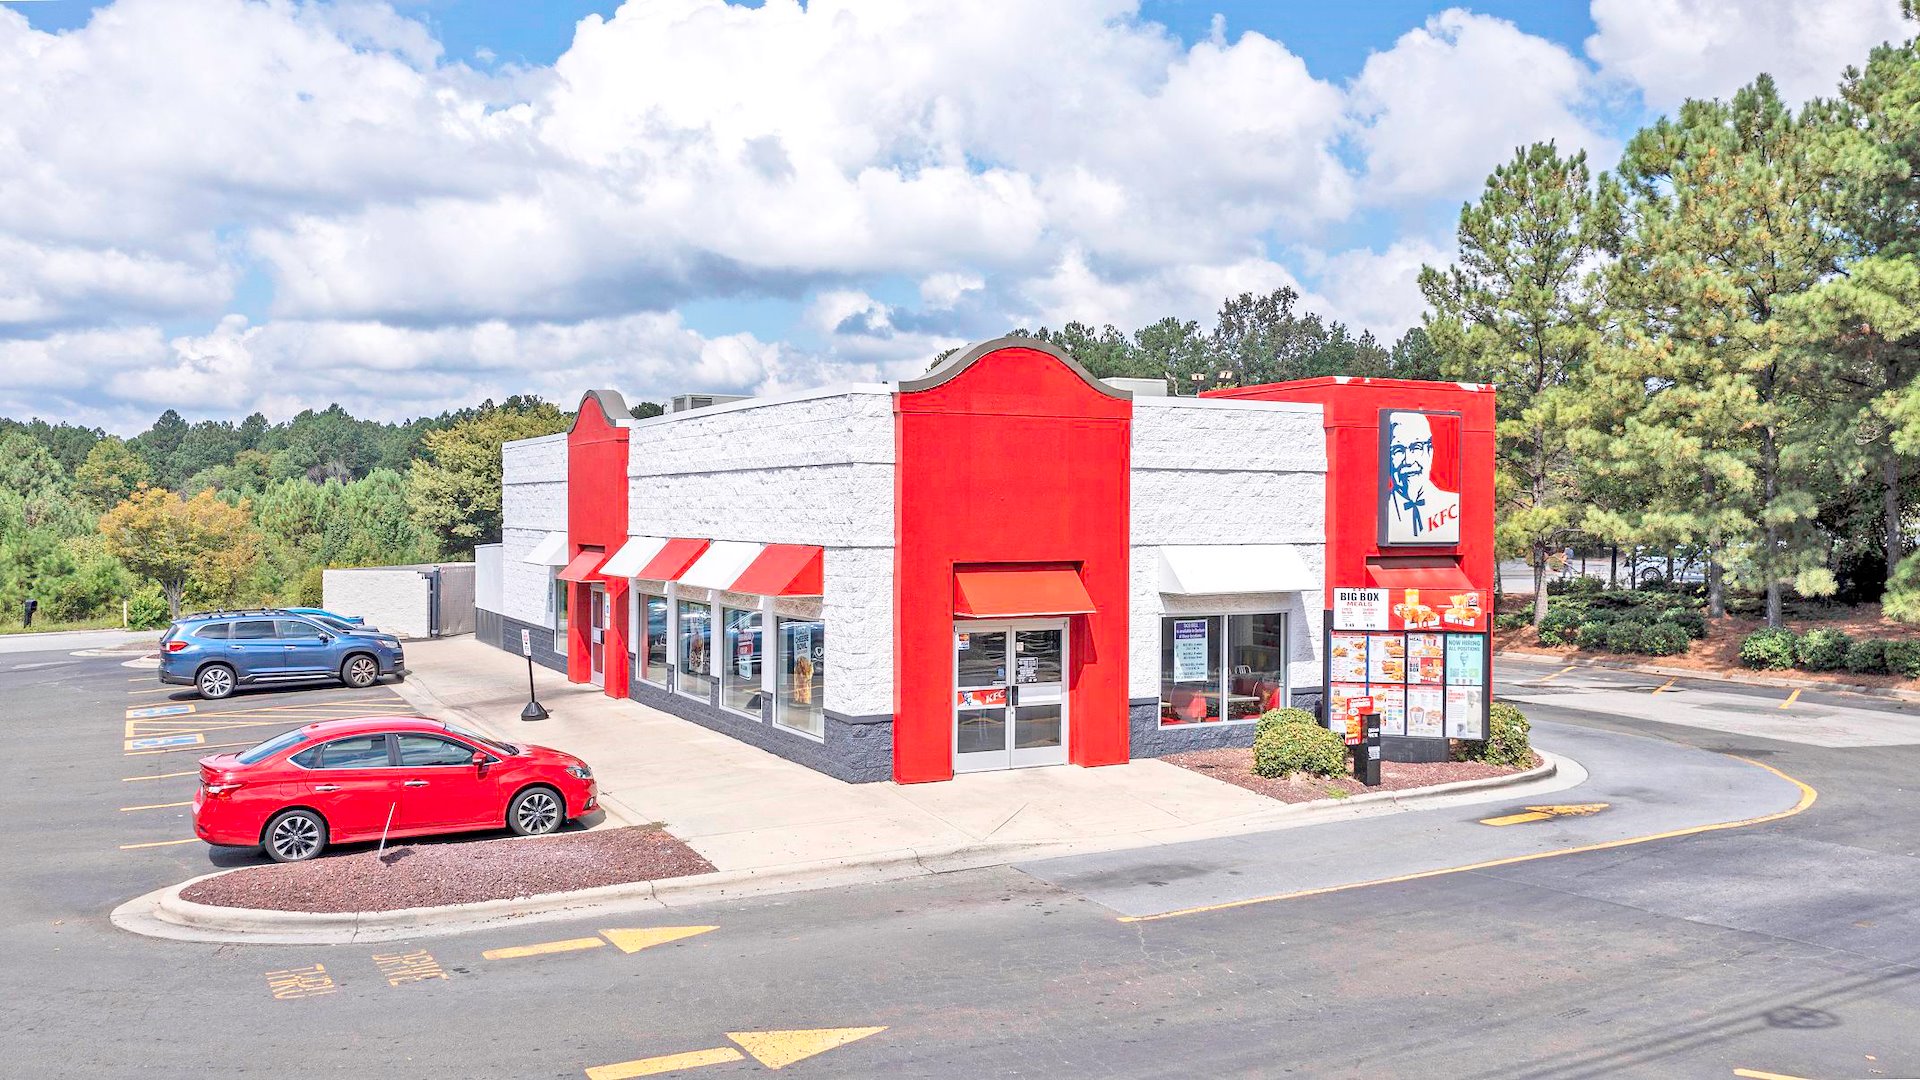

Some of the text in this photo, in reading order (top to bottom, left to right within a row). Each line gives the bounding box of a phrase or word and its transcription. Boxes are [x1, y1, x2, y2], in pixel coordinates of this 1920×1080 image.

[1428, 504, 1458, 533] KFC
[1340, 592, 1379, 601] BIG BOX
[986, 689, 1006, 704] KFC
[264, 963, 338, 1000] THRU
[372, 948, 450, 987] DRIVE
